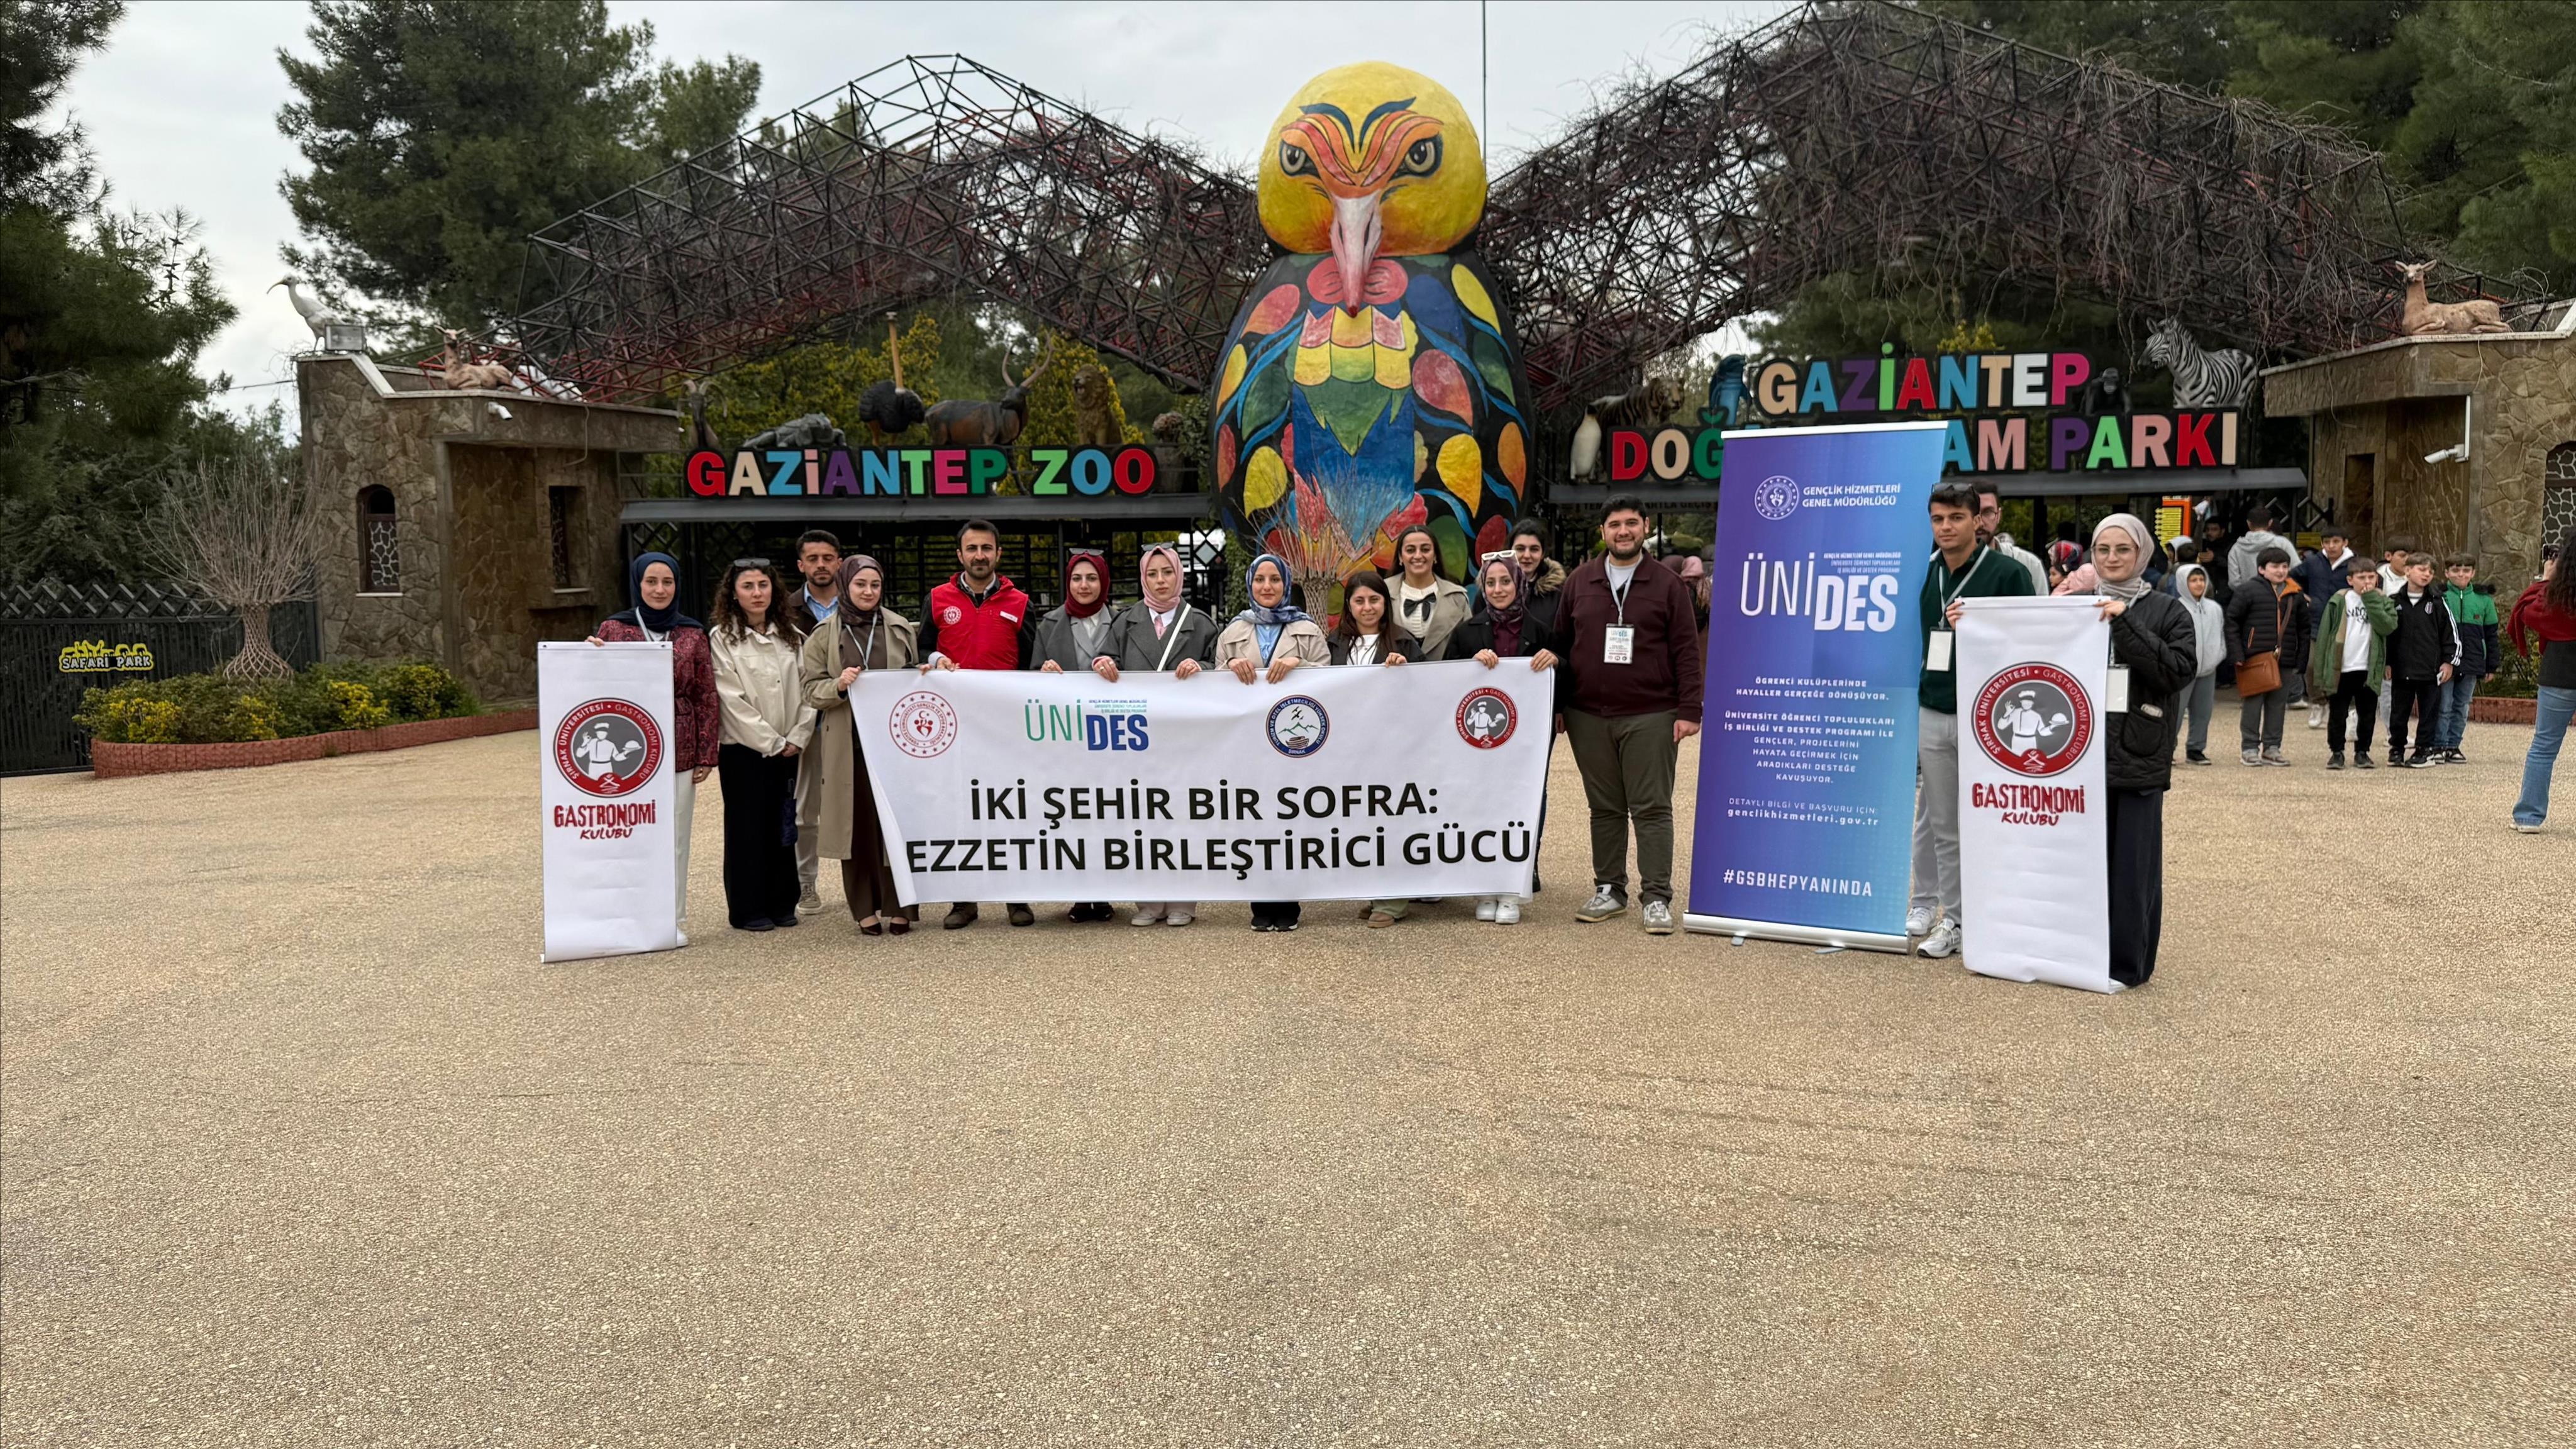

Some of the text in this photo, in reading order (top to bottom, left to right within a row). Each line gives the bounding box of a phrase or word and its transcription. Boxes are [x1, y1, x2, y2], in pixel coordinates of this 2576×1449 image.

[1759, 343, 2090, 413] GAZİANTEP
[1612, 408, 1723, 480] DOĞ
[2051, 411, 2237, 471] PARKI
[687, 448, 1155, 496] GAZİANTEP ZOO
[1802, 483, 1901, 497] GENÇLİK HİZMETLERİ
[1802, 495, 1896, 508] GENEL MÜDÜRLÜĞÜ
[116, 656, 151, 667] PARK
[1797, 677, 1867, 687] KULÜPLERİNDE
[1736, 689, 1889, 701] HAYALLER GERÇEĞE DÖNÜŞÜYOR.
[1724, 710, 1896, 725] ÜNİVERSİTE ÖĞRENCİ TOPLULUKLARI
[1724, 723, 1733, 731] İŞ
[1736, 723, 1770, 733] BİRLİĞİ
[1787, 726, 1823, 735] DESTEK
[1825, 728, 1875, 737] PROGRAMI
[1879, 728, 1894, 738] İLE
[1799, 738, 1860, 748] PROJELERİNİ
[1752, 748, 1858, 762] HAYATA GEÇİRMEK İÇİN
[1756, 761, 1856, 773] ARADIKLARI DESTEĞE
[1775, 774, 1834, 784] KAVUŞUYOR.
[971, 779, 1438, 830] İKİ ŞEHİR BİR SOFRA:
[1729, 797, 1765, 807] DETAYLI
[1767, 800, 1791, 809] BİLGİ
[1794, 802, 1806, 810] VE
[1809, 804, 1853, 814] BAŞVURU
[1972, 782, 2085, 814] GASTRONOMİ
[553, 799, 657, 828] GASTRONOMİ
[1728, 808, 1879, 826] genclikhizmetleri.gov.tr
[1104, 826, 1384, 880] BİRLEŞTİRİCİ
[1402, 821, 1531, 865] GÜCÜ
[1723, 869, 1872, 897] #GSBHEPYANINDA
